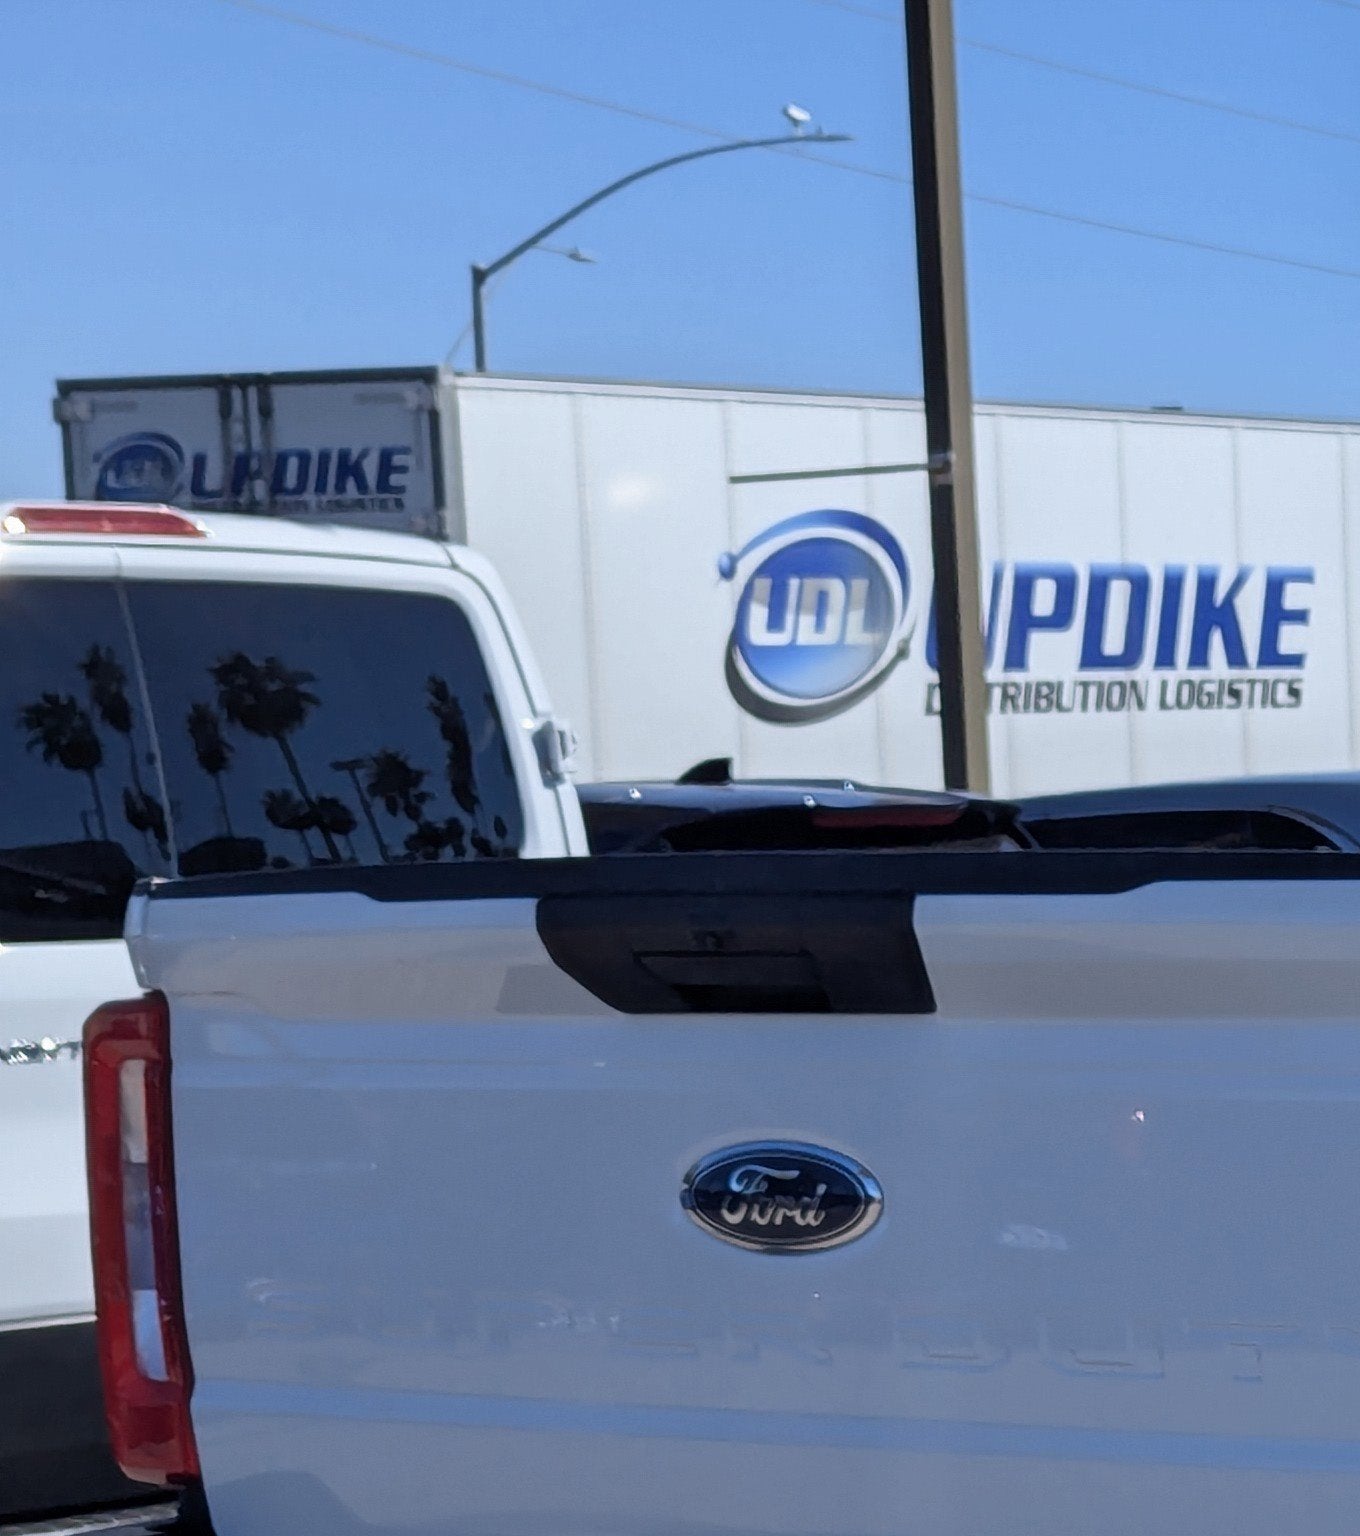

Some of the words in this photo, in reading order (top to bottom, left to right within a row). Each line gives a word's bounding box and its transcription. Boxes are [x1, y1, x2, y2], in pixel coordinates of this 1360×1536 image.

[746, 575, 878, 647] UDL
[925, 679, 1149, 716] DTRIBUTION
[1159, 677, 1304, 712] LOGISTICS
[720, 1163, 827, 1228] Ford
